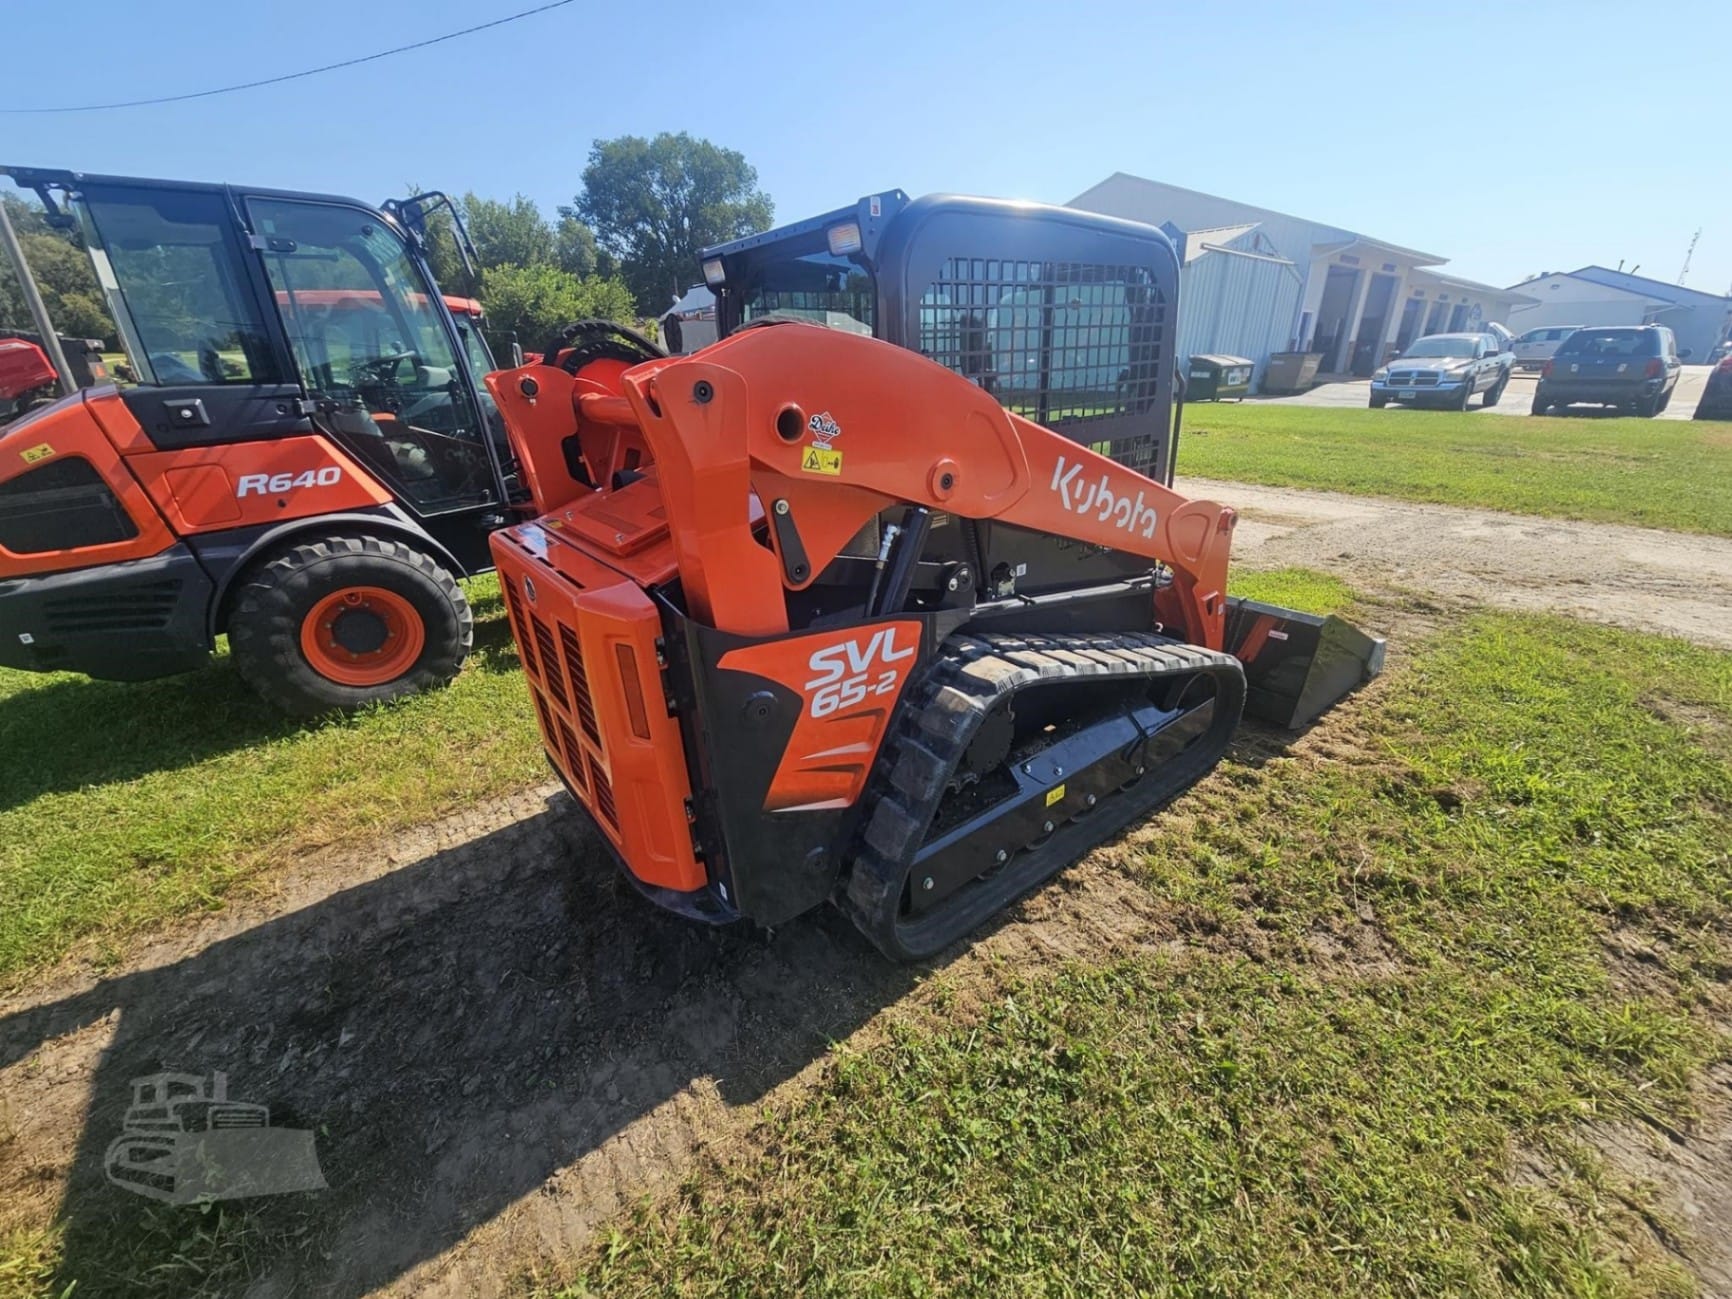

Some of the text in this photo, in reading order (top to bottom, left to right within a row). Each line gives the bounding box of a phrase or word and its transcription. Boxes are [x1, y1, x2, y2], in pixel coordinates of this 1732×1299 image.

[237, 466, 341, 497] R640
[1050, 456, 1157, 539] Kubota
[805, 627, 914, 691] SVL
[811, 670, 897, 718] 65-2
